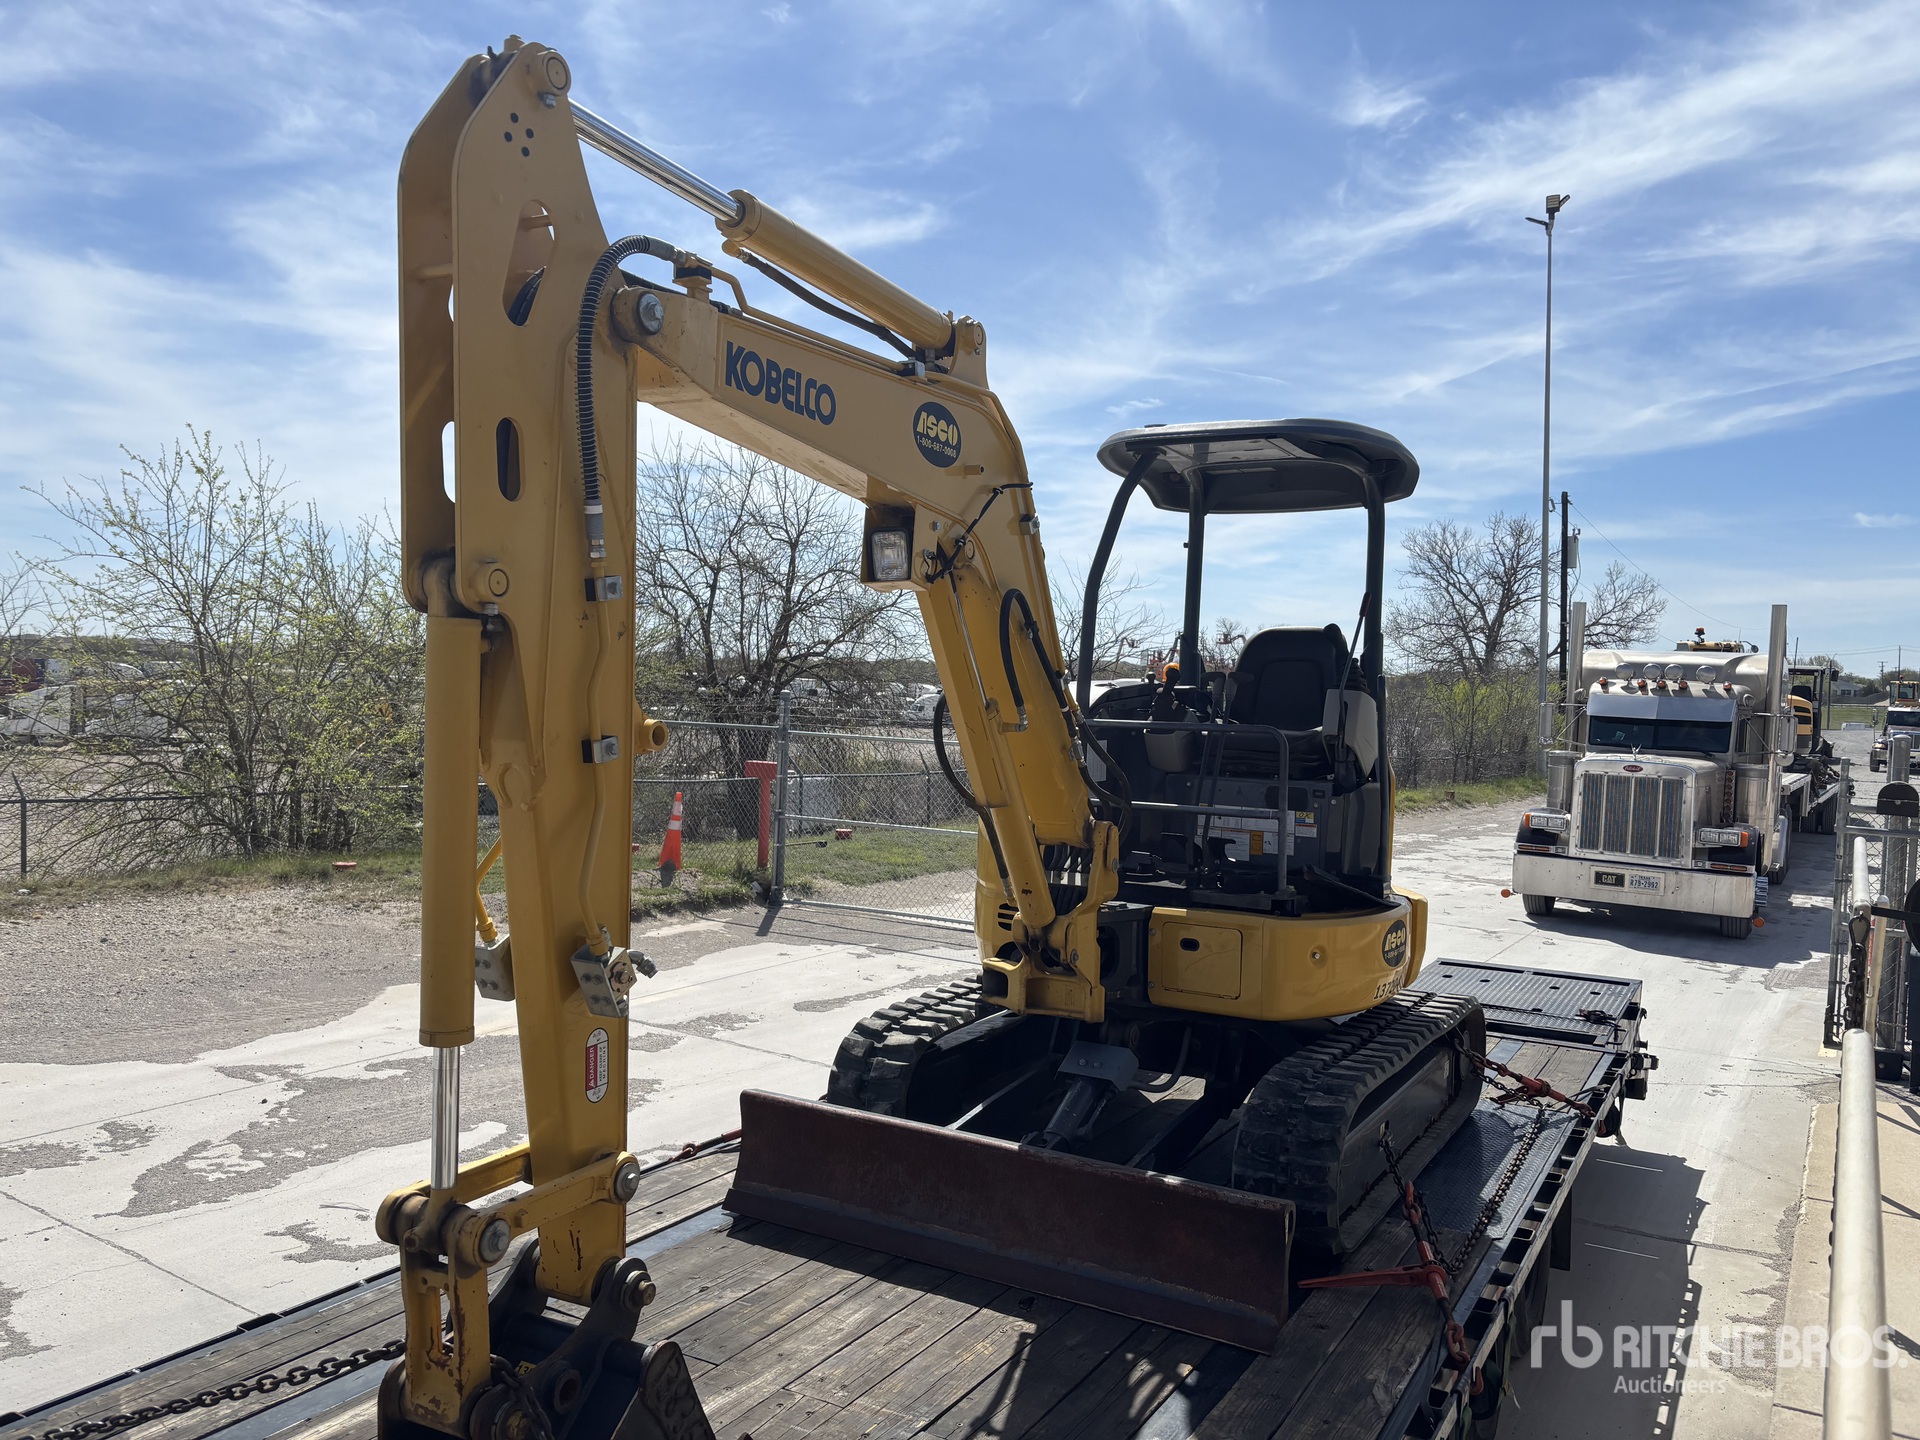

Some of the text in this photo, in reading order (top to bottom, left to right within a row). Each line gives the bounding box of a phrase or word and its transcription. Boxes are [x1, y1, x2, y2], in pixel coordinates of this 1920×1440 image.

[725, 340, 837, 426] KOBELCO
[916, 410, 958, 447] ASCO
[1602, 874, 1617, 884] CAT
[1384, 927, 1406, 952] ASCO
